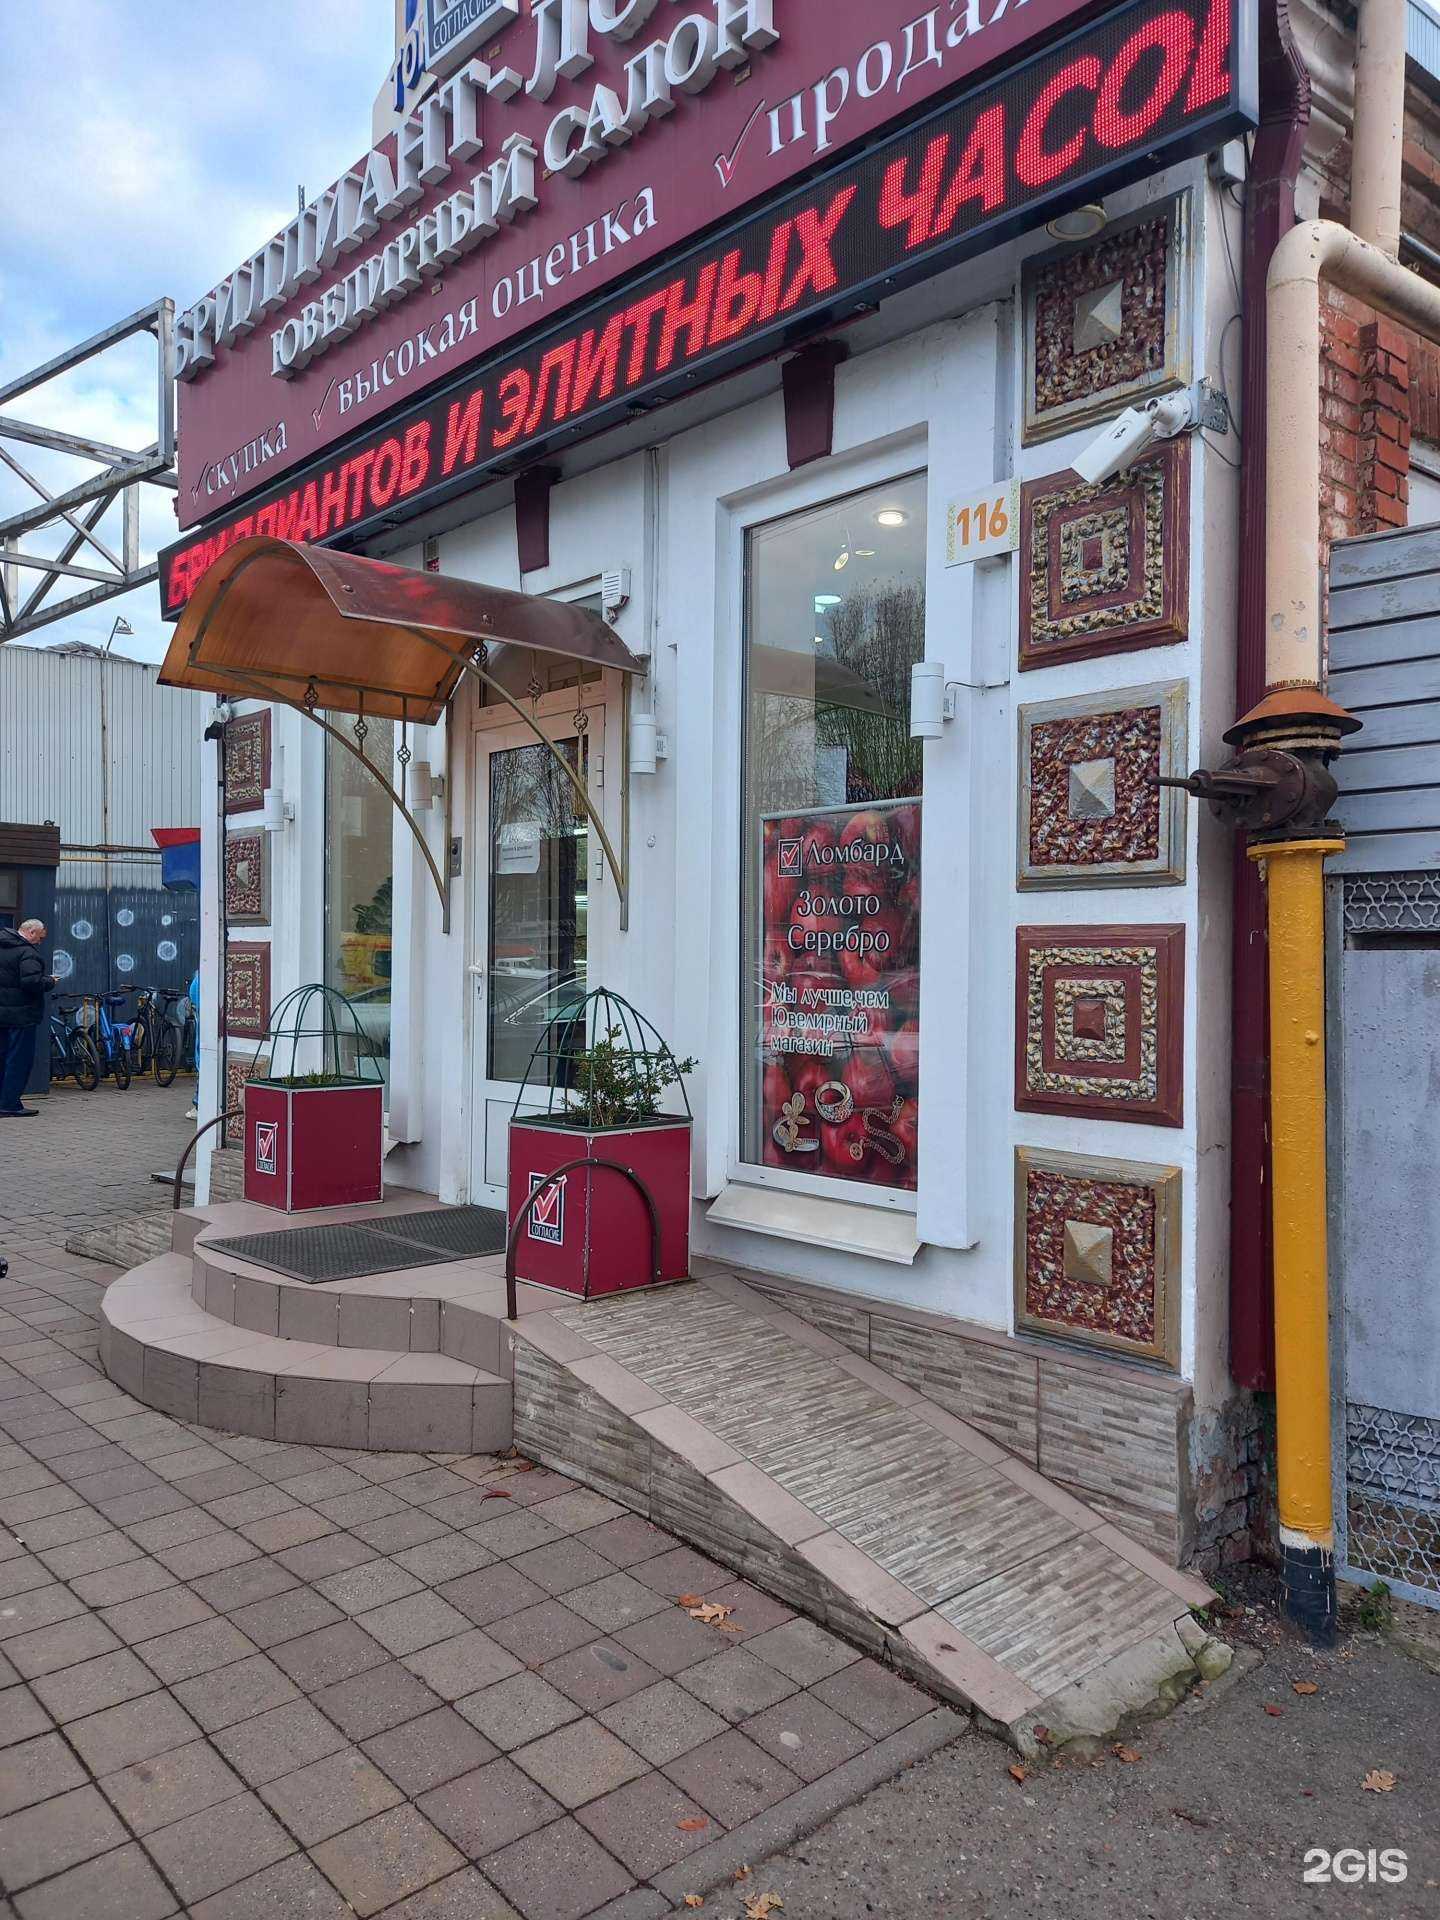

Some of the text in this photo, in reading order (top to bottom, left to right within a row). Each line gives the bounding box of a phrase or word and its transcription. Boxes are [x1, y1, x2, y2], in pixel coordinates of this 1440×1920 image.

[271, 132, 538, 380] ЮВЕЛИРНЫЙ
[206, 420, 288, 497] скупка
[337, 296, 479, 415] высокая
[492, 185, 658, 319] оценка
[441, 388, 483, 477] И
[493, 184, 858, 448] ЭЛИТНЫХ
[956, 495, 1009, 546] 116
[806, 838, 905, 867] Ломбард
[797, 890, 880, 917] Золото
[787, 924, 890, 957] Серебро
[771, 981, 797, 1004] Мы
[771, 1006, 868, 1034] Ювелирный
[771, 1035, 834, 1057] магазин
